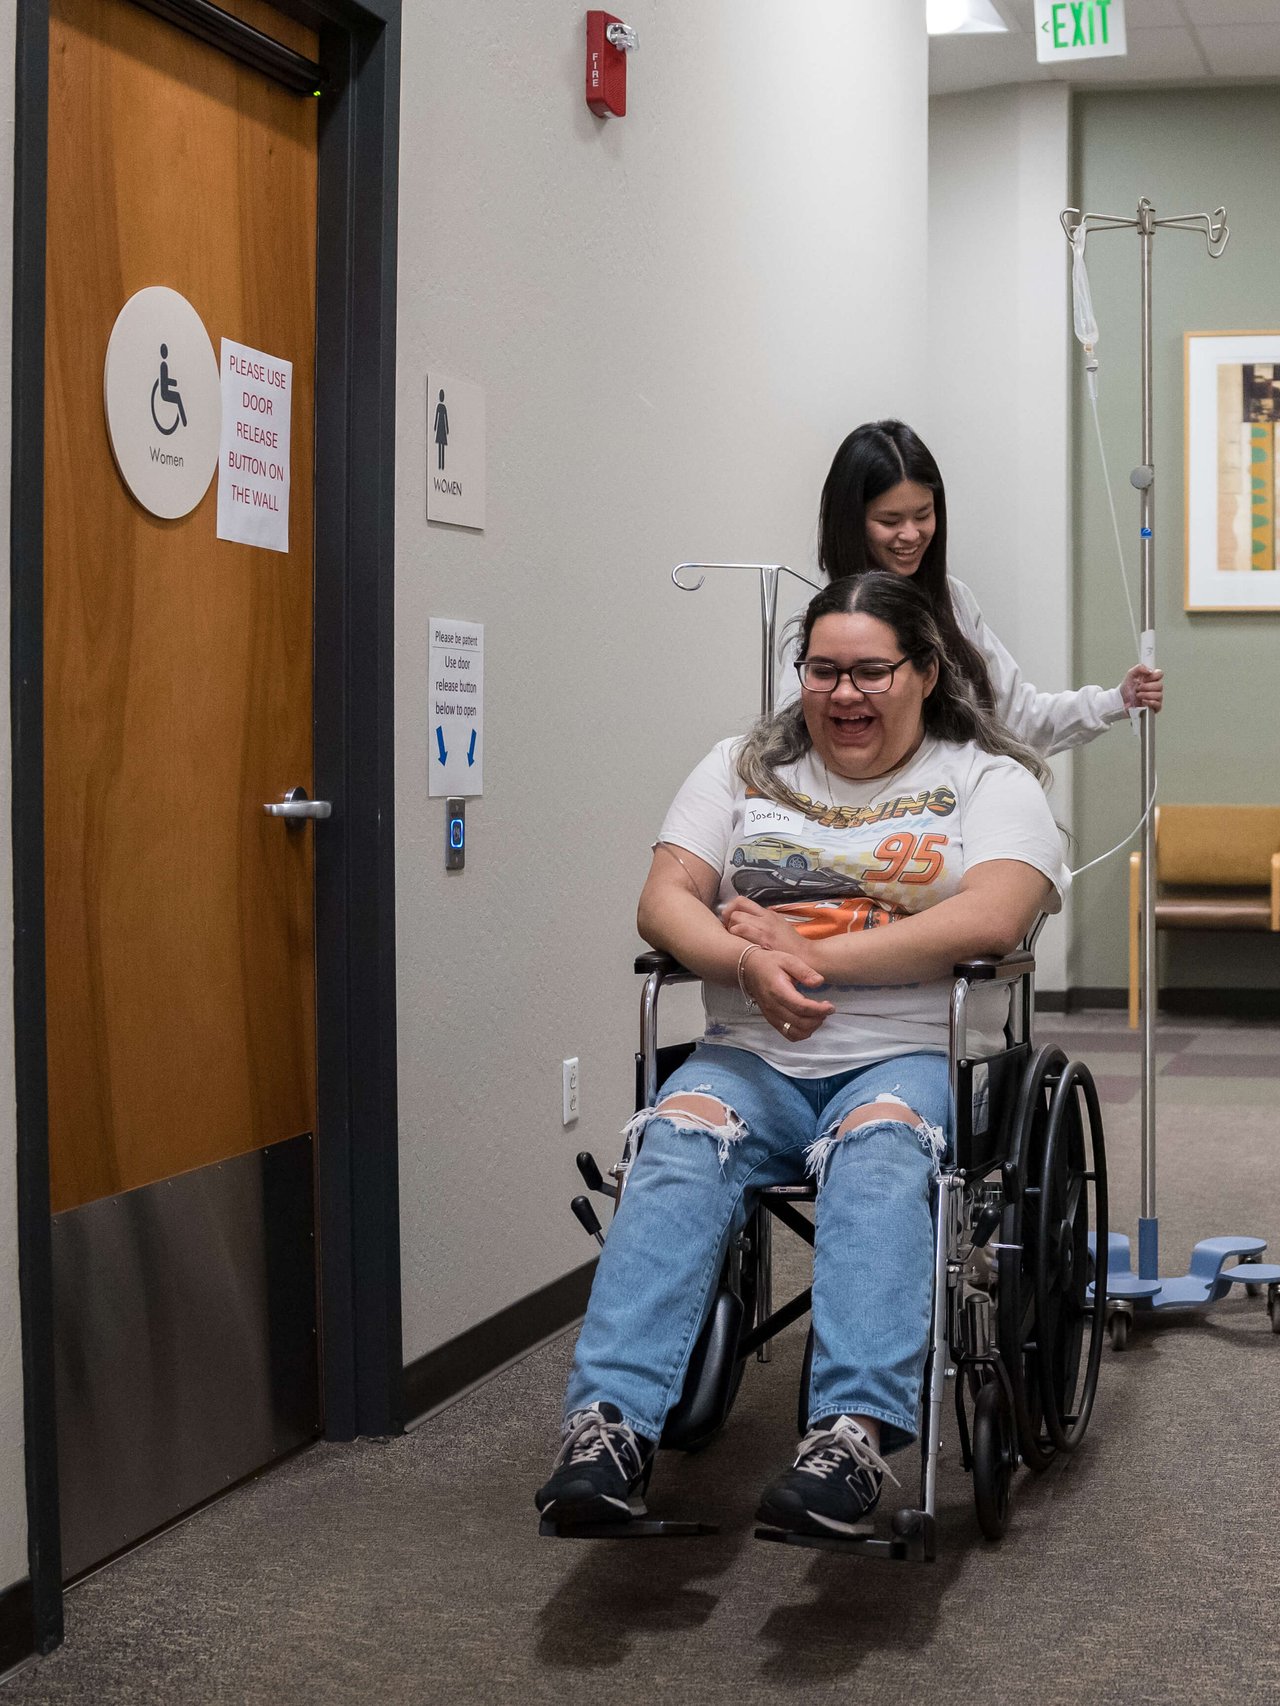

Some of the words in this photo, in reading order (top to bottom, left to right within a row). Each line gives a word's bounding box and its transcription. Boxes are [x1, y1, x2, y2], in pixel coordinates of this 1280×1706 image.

[1051, 0, 1112, 48] EXIT
[592, 52, 600, 87] FIRE
[230, 355, 265, 382] PLEASE
[267, 369, 286, 390] USE
[242, 391, 273, 416] DOOR
[236, 421, 278, 449] RELEASE
[149, 446, 184, 467] Women
[229, 451, 266, 477] BUTTON
[269, 463, 284, 481] ON
[231, 484, 251, 505] THE
[252, 489, 279, 512] WALL
[433, 476, 462, 496] WOMEN
[435, 630, 454, 644] Please
[455, 632, 462, 645] be
[462, 636, 478, 647] patient
[445, 655, 457, 669] Use
[458, 656, 471, 670] door
[436, 678, 459, 692] release
[460, 680, 477, 694] button
[436, 701, 456, 715] below
[457, 703, 463, 716] to
[464, 706, 477, 719] open
[748, 809, 791, 823] Joselyn
[862, 832, 950, 885] 95
